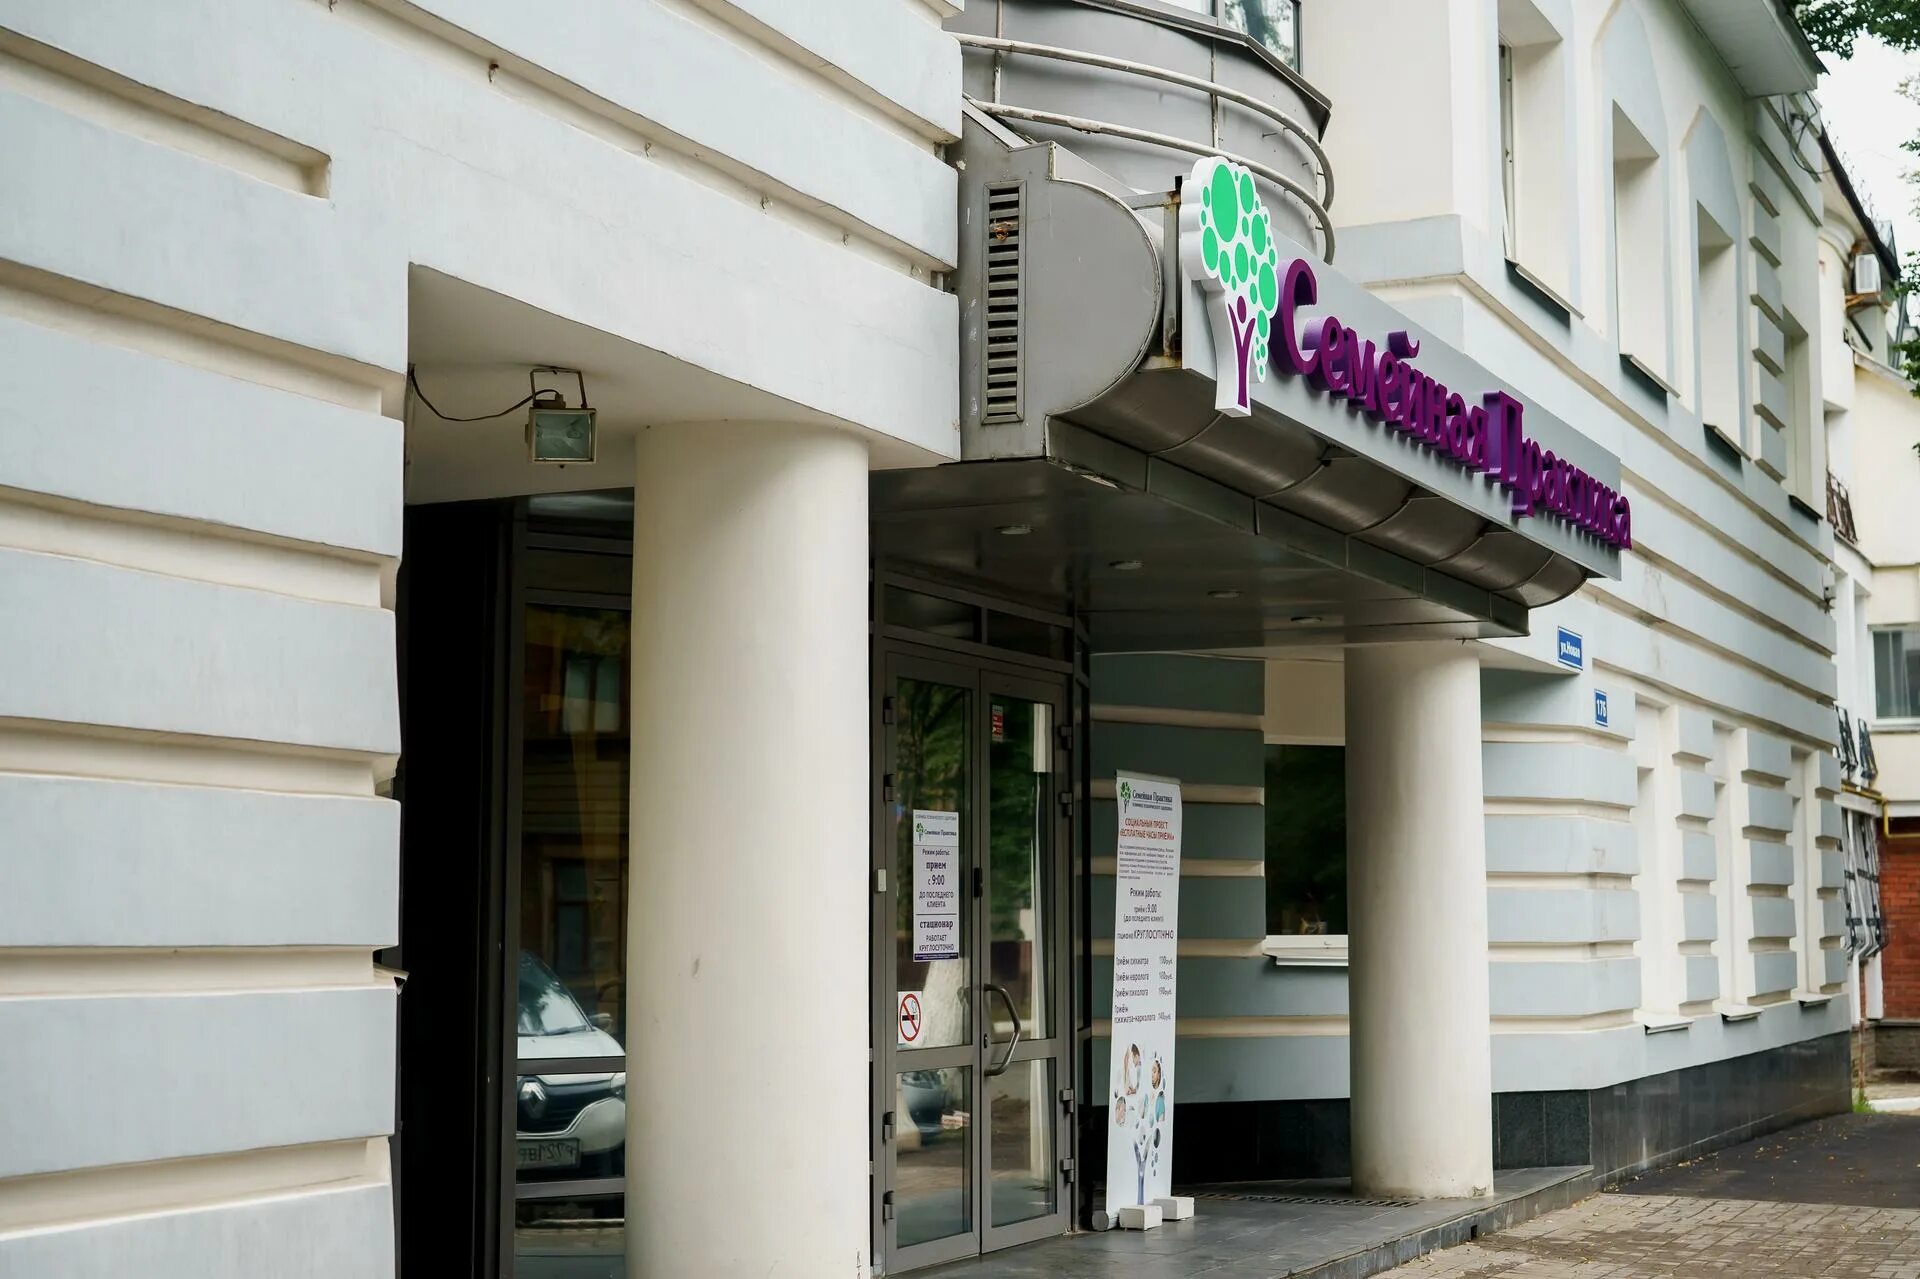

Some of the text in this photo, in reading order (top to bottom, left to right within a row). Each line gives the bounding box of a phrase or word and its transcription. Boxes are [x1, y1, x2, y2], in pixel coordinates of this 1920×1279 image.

[1270, 258, 1632, 550] Семейная Практика
[922, 848, 935, 856] Режим
[926, 862, 947, 872] прием
[932, 874, 945, 886] 9:00
[919, 891, 954, 899] ДО ПОСЛЕДНЕГО
[1130, 887, 1144, 897] Режим
[920, 921, 954, 930] стационар
[926, 934, 947, 942] РАБОТАЕТ
